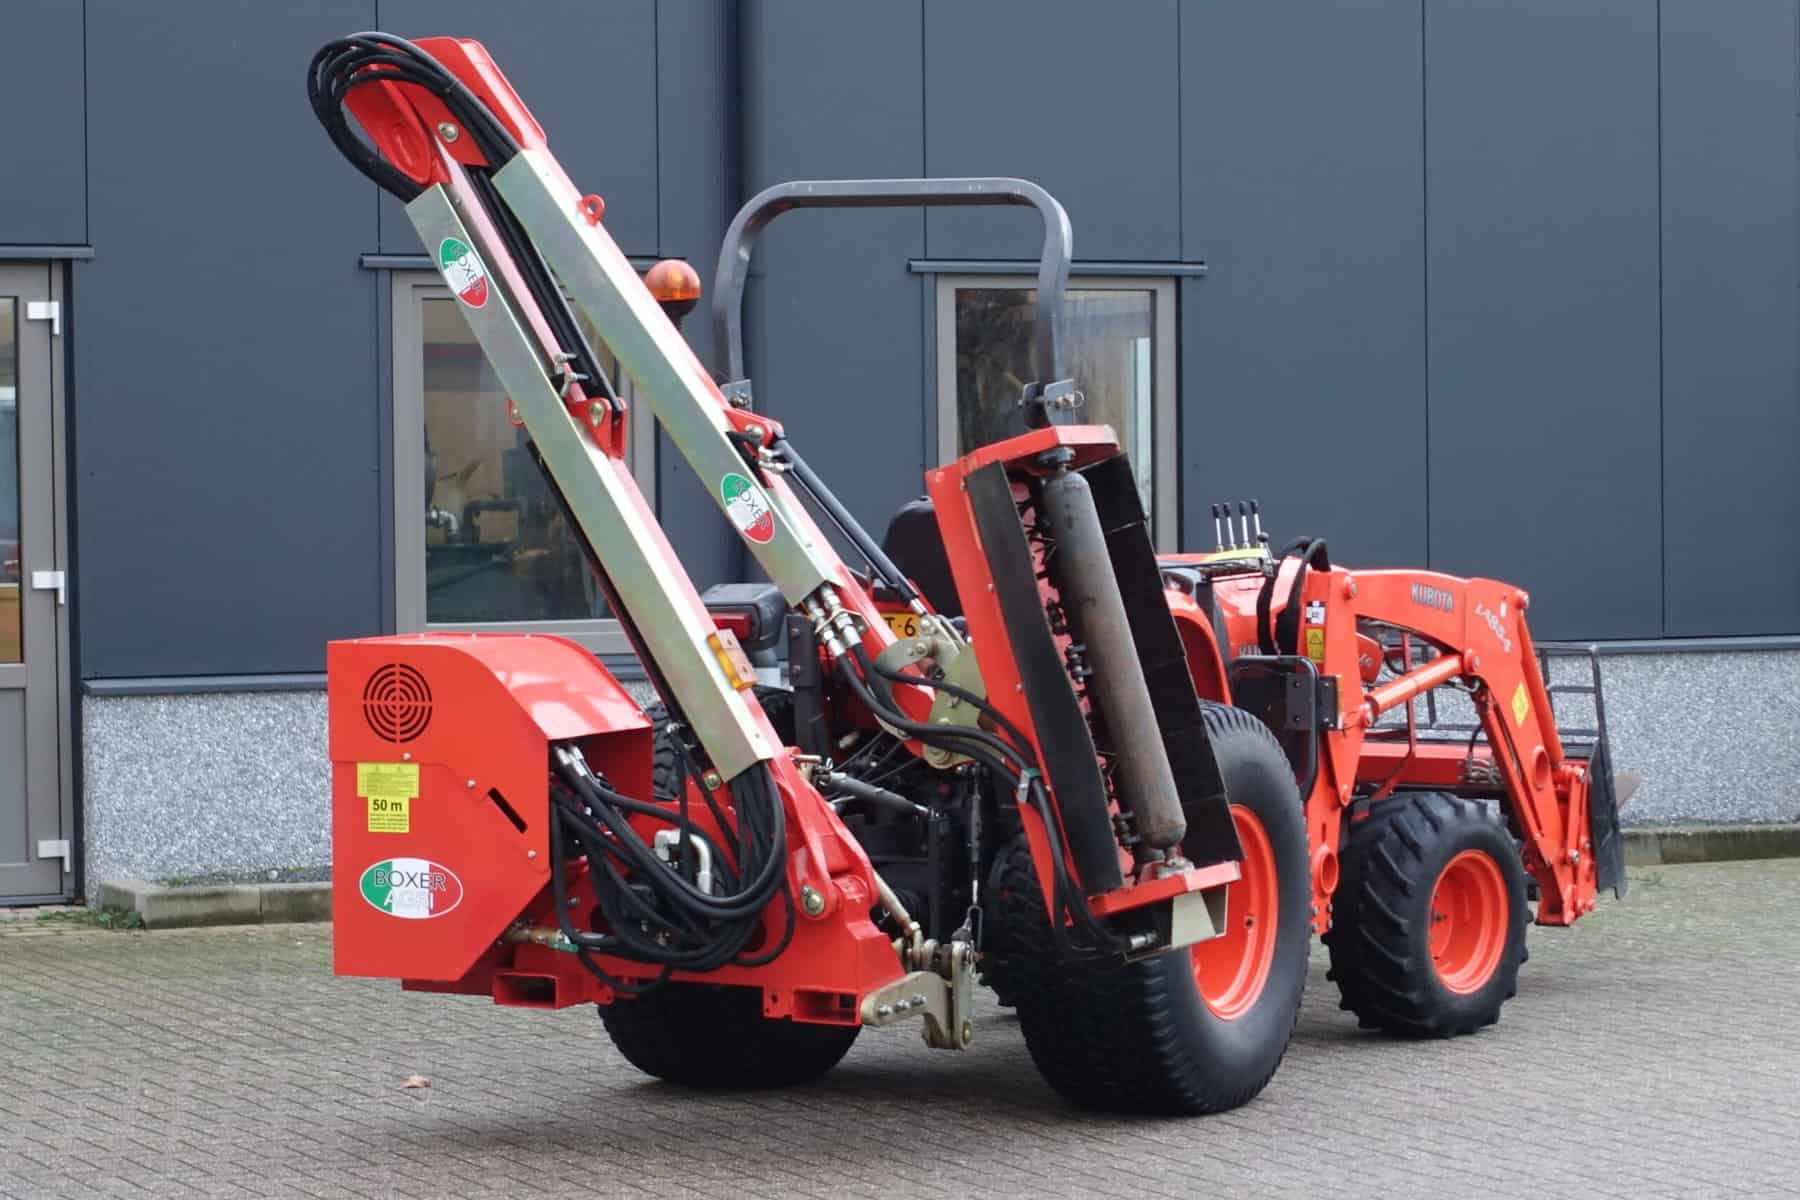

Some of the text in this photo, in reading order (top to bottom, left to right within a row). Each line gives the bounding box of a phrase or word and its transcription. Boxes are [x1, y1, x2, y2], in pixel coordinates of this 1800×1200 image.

[1411, 583, 1454, 613] KUBOTA
[373, 799, 402, 811] 50 m
[375, 869, 447, 891] BOXER
